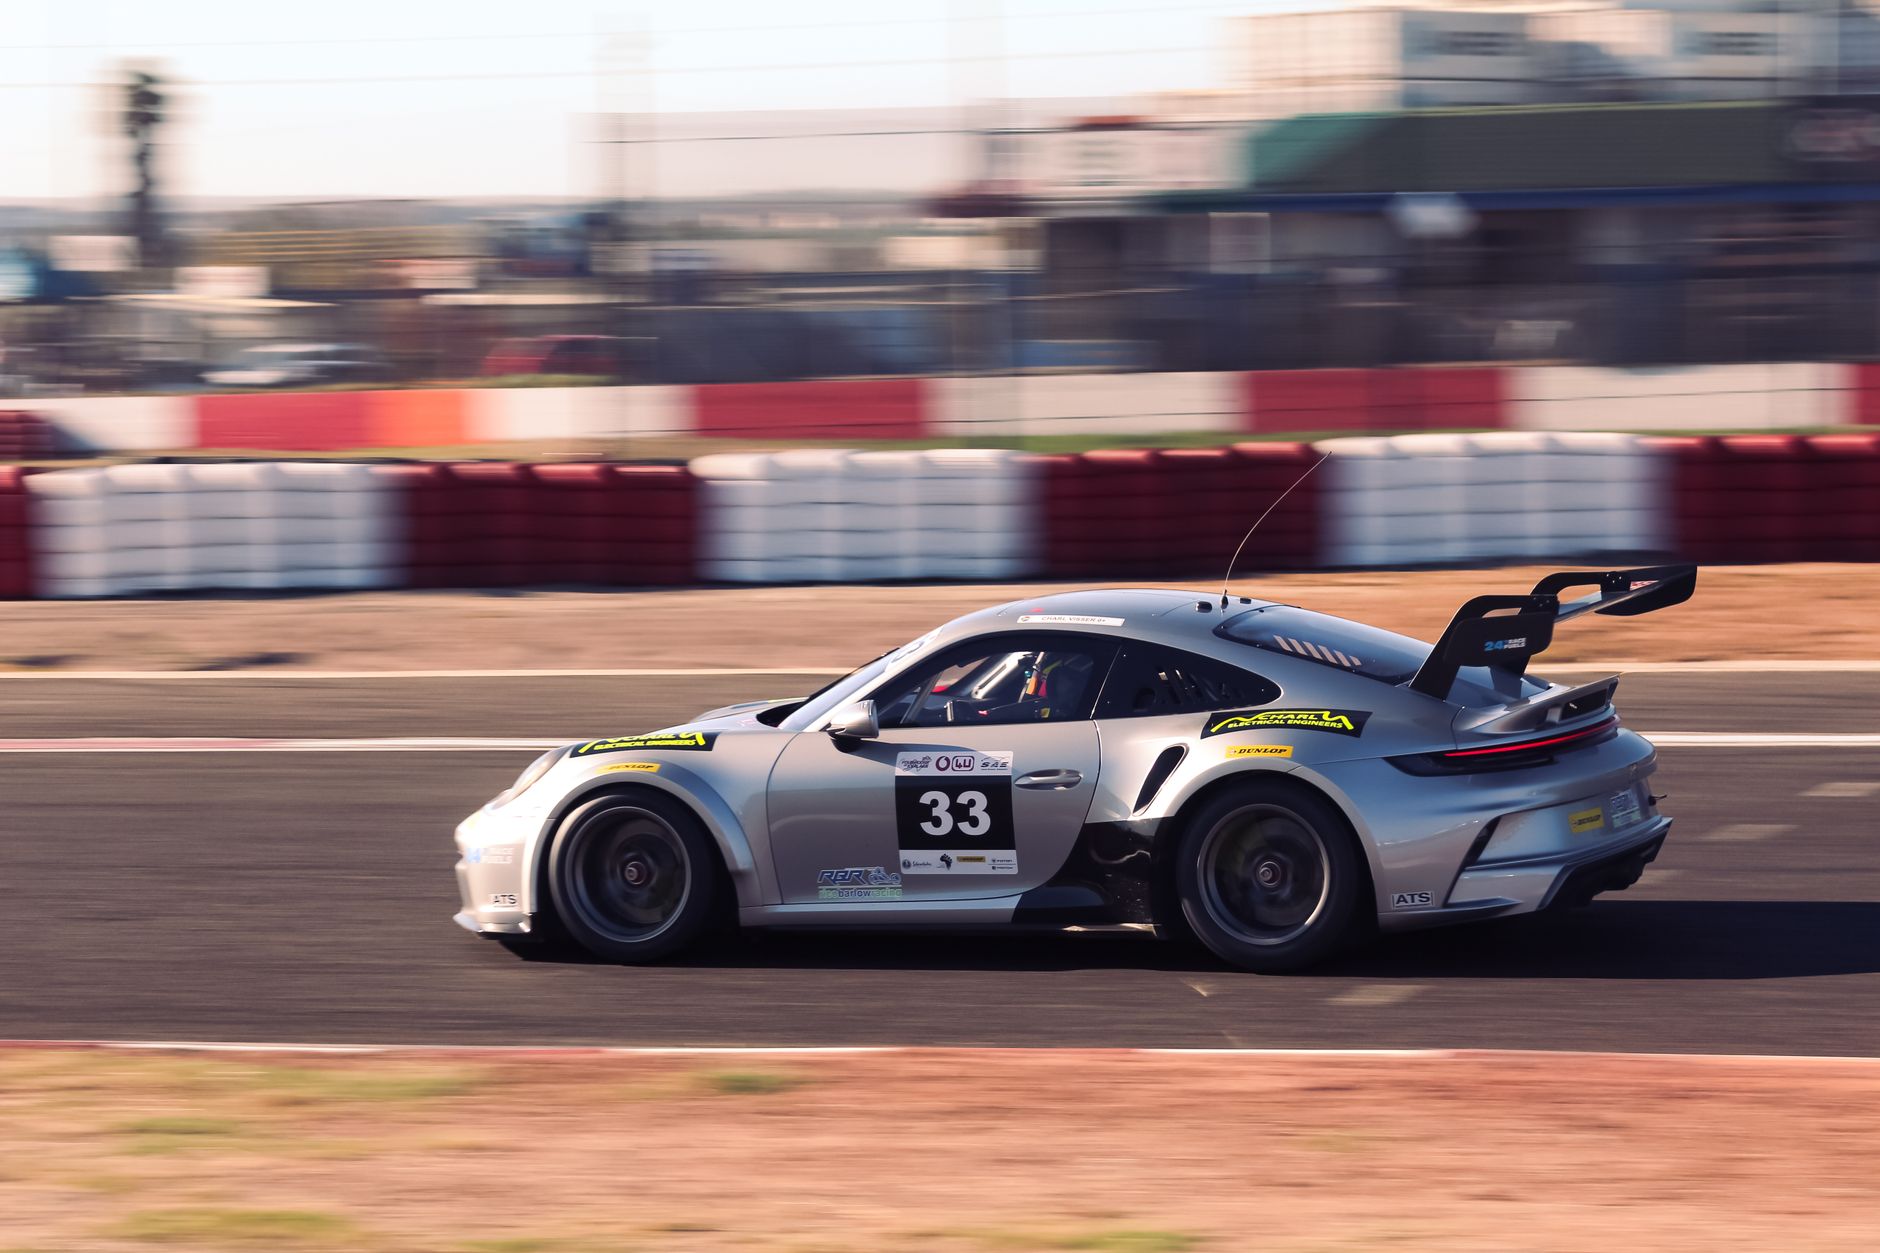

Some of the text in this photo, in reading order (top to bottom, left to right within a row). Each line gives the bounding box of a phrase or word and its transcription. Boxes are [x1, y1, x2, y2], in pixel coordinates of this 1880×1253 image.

[1257, 711, 1319, 720] CHARL
[1227, 718, 1344, 729] ELECTRICAL ENGINEERS
[918, 790, 991, 836] 33
[1395, 892, 1431, 905] ATS
